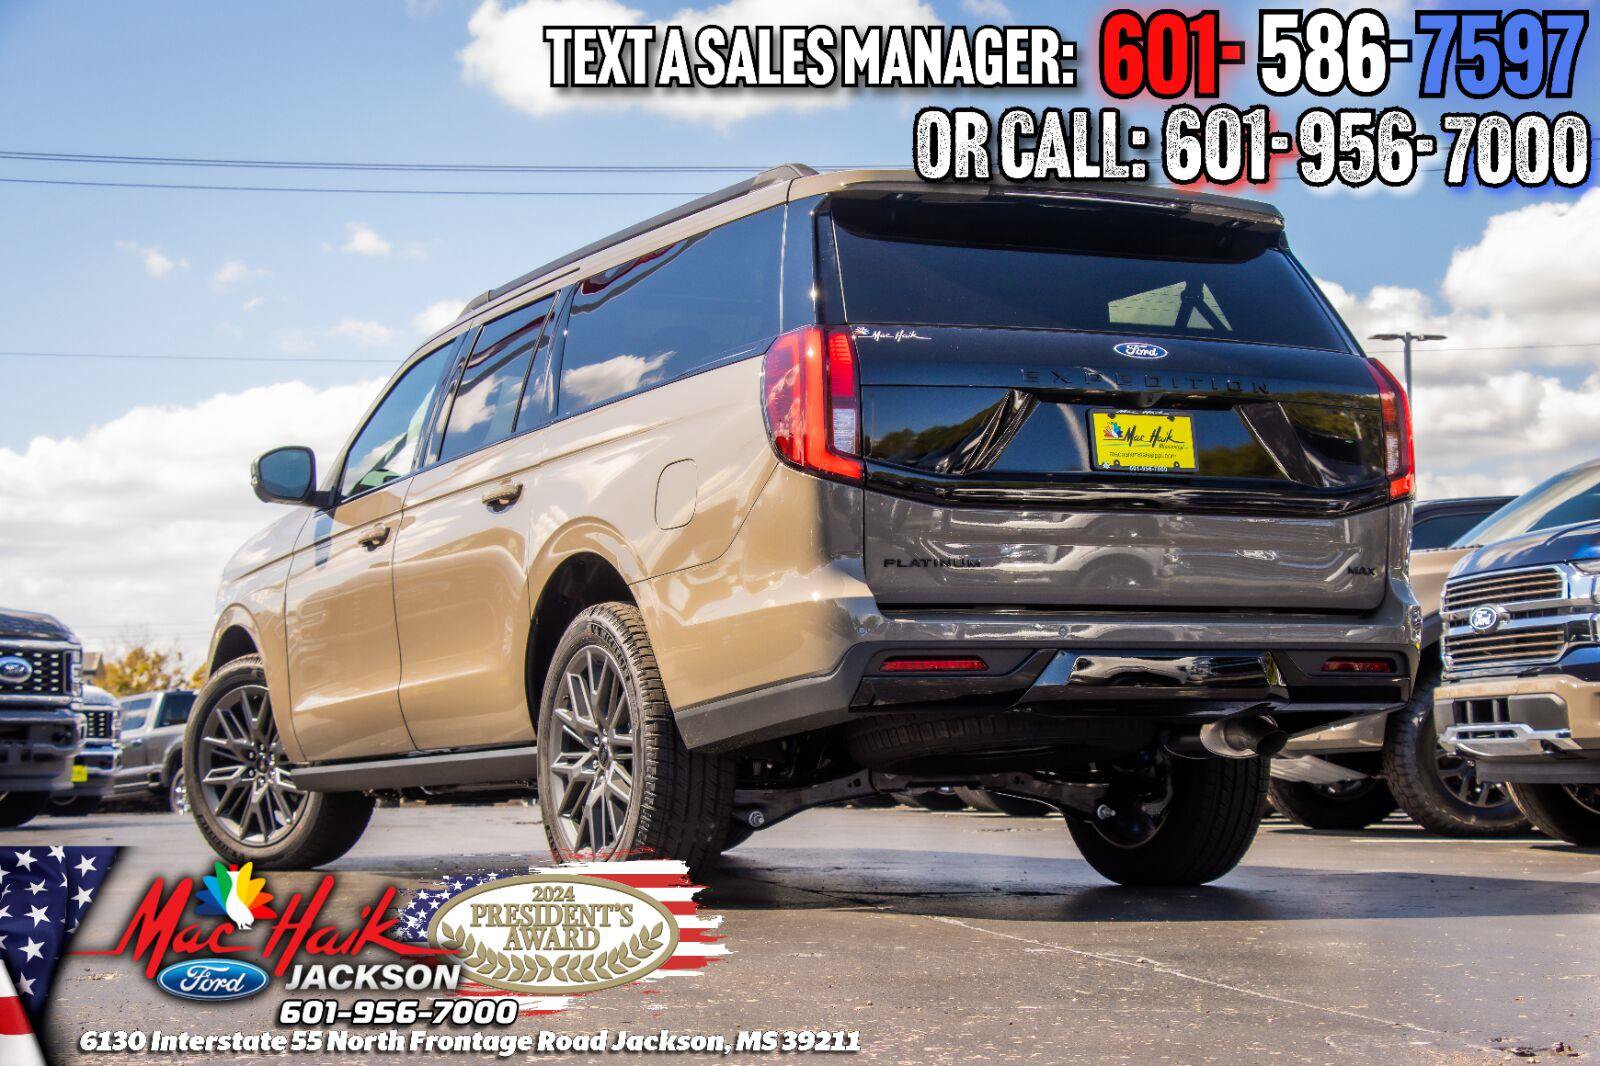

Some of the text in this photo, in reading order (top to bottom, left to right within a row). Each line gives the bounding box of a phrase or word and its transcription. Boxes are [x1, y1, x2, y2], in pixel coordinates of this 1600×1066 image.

[1125, 343, 1158, 358] Ford
[1021, 368, 1270, 394] EXPEDITION
[1123, 424, 1176, 448] Mac Haik
[883, 558, 981, 568] PLATINUM
[1347, 566, 1376, 576] MAX
